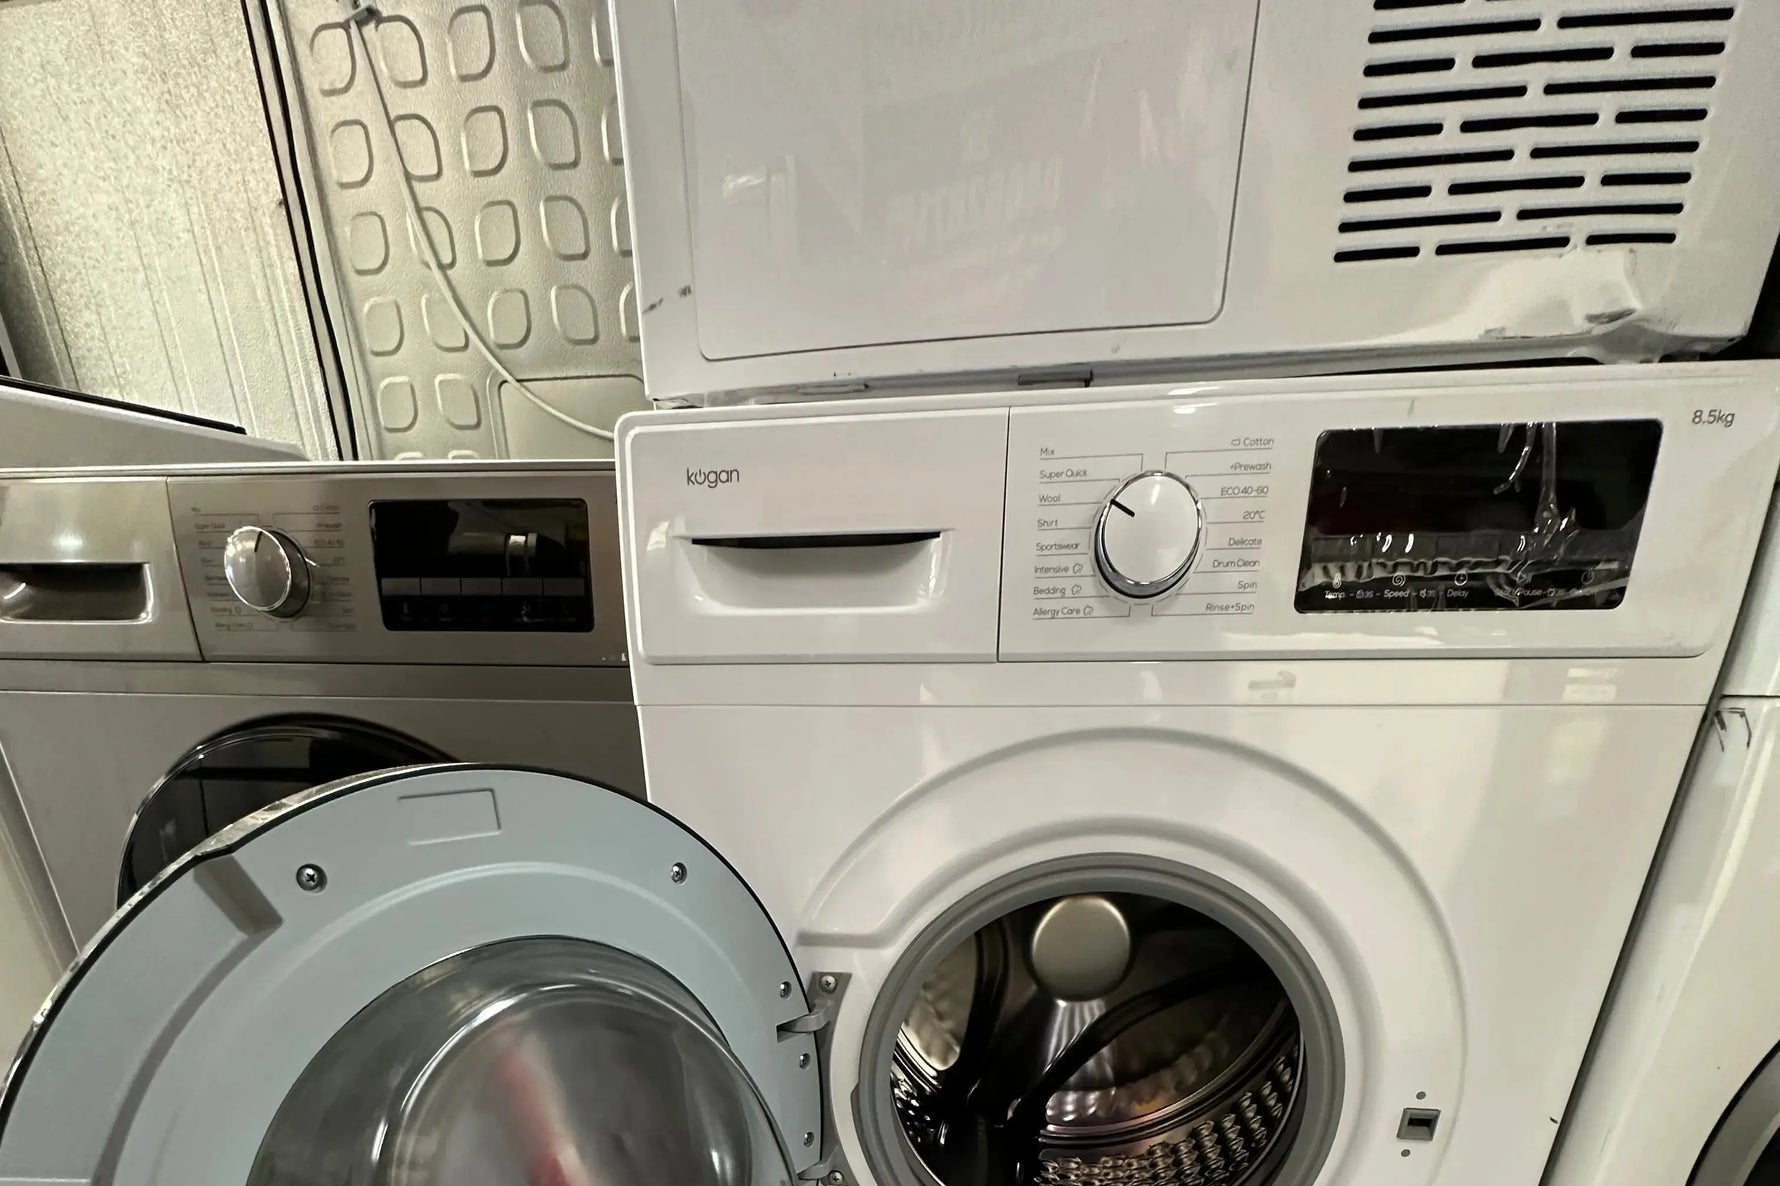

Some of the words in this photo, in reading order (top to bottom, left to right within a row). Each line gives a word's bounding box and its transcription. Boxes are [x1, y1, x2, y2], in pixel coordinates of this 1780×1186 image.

[1691, 409, 1735, 428] 8.5kg
[1243, 437, 1274, 447] Cotton
[1040, 447, 1055, 456] Mix
[686, 467, 740, 489] kogan
[1039, 470, 1064, 480] Super
[1065, 468, 1088, 478] Quick
[1220, 486, 1240, 496] ECO
[1038, 493, 1061, 503] Wool
[1037, 518, 1058, 528] Shirt
[1035, 542, 1081, 553] Sportswear
[1228, 537, 1263, 547] Delicate
[1212, 559, 1236, 568] Drum
[1236, 558, 1261, 567] Clean
[1034, 565, 1070, 574] Intensive
[1237, 580, 1258, 591] Spin
[1033, 586, 1066, 598] Bedding
[1383, 589, 1410, 600] Speed
[1032, 607, 1060, 619] Allergy
[1060, 606, 1081, 616] Care
[1205, 602, 1255, 614] Rinse+Spin
